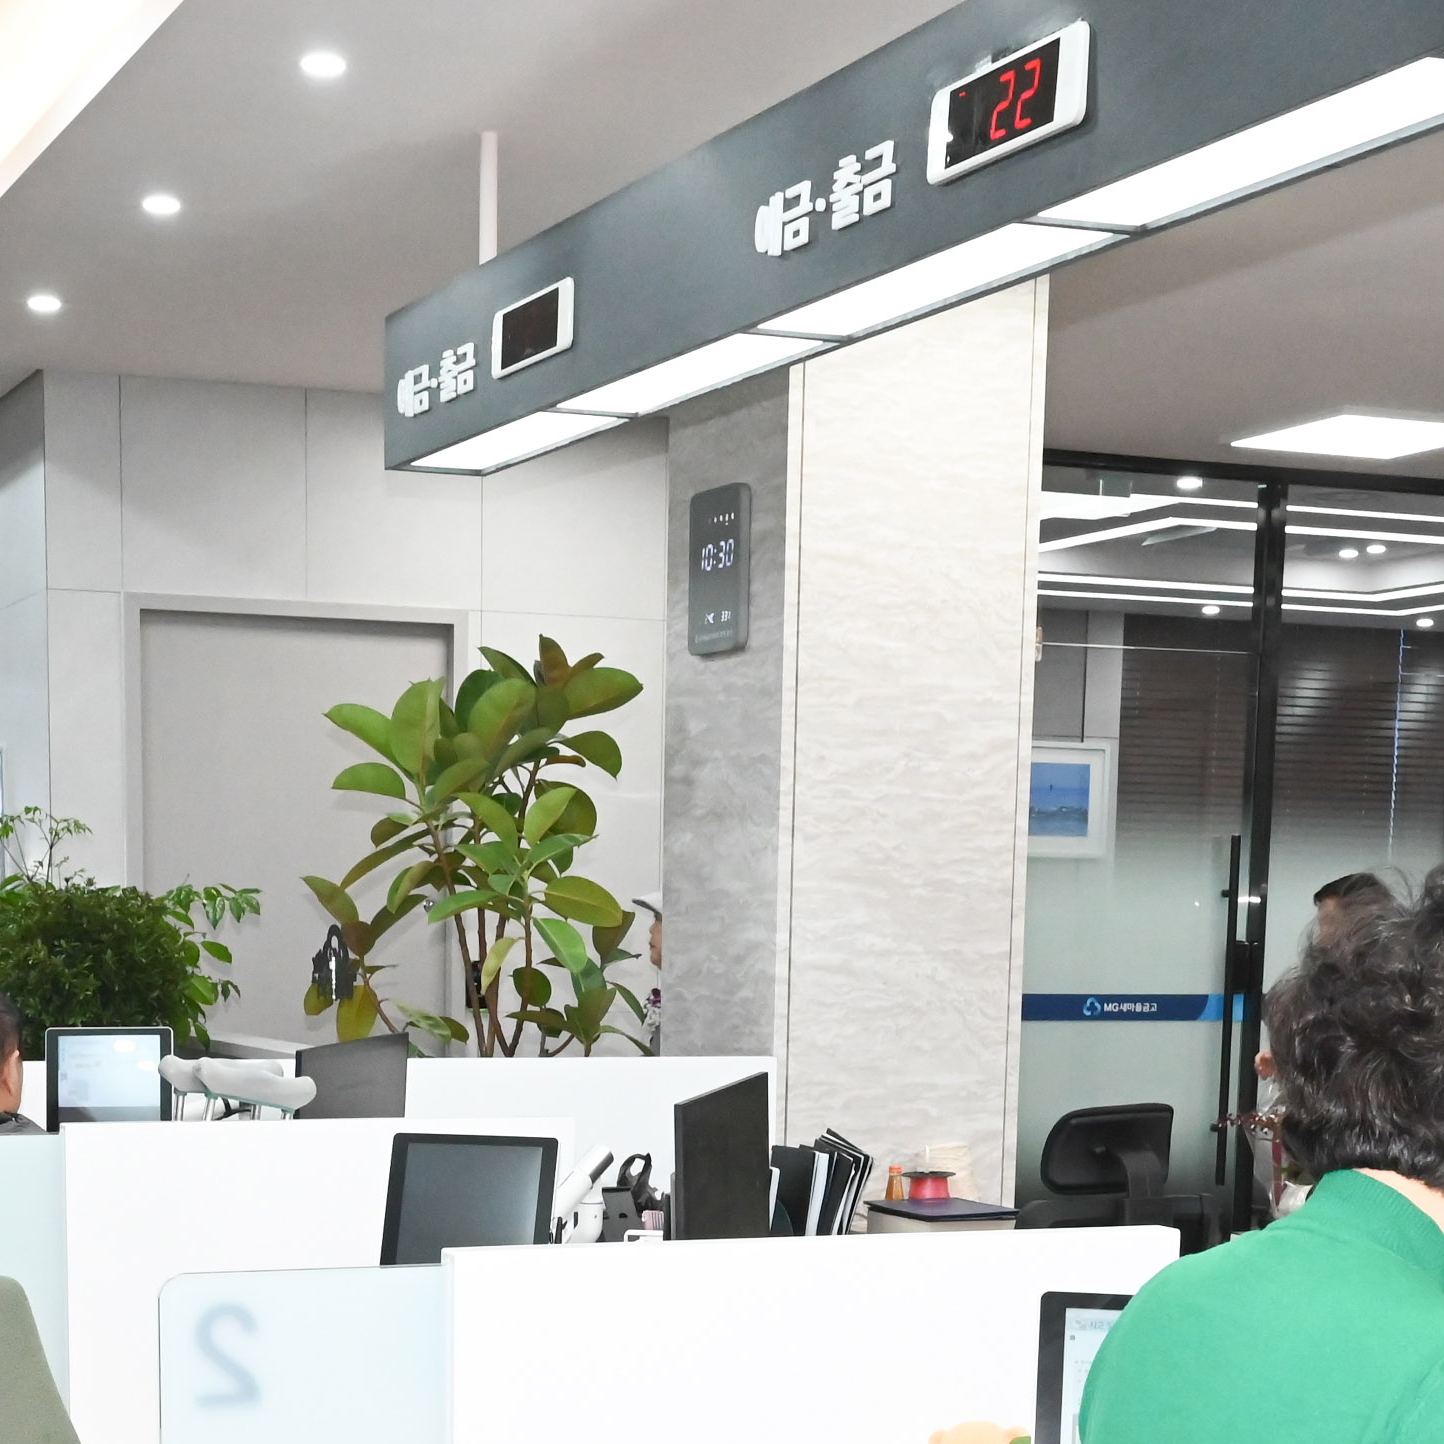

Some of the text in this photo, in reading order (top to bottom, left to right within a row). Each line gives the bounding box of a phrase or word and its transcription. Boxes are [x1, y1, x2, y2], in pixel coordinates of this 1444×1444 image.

[990, 58, 1042, 141] 22
[755, 140, 897, 257] 예금·출금
[397, 342, 476, 417] 예금·출금
[701, 538, 735, 572] 10:30
[1103, 1002, 1158, 1013] MG새마을금고
